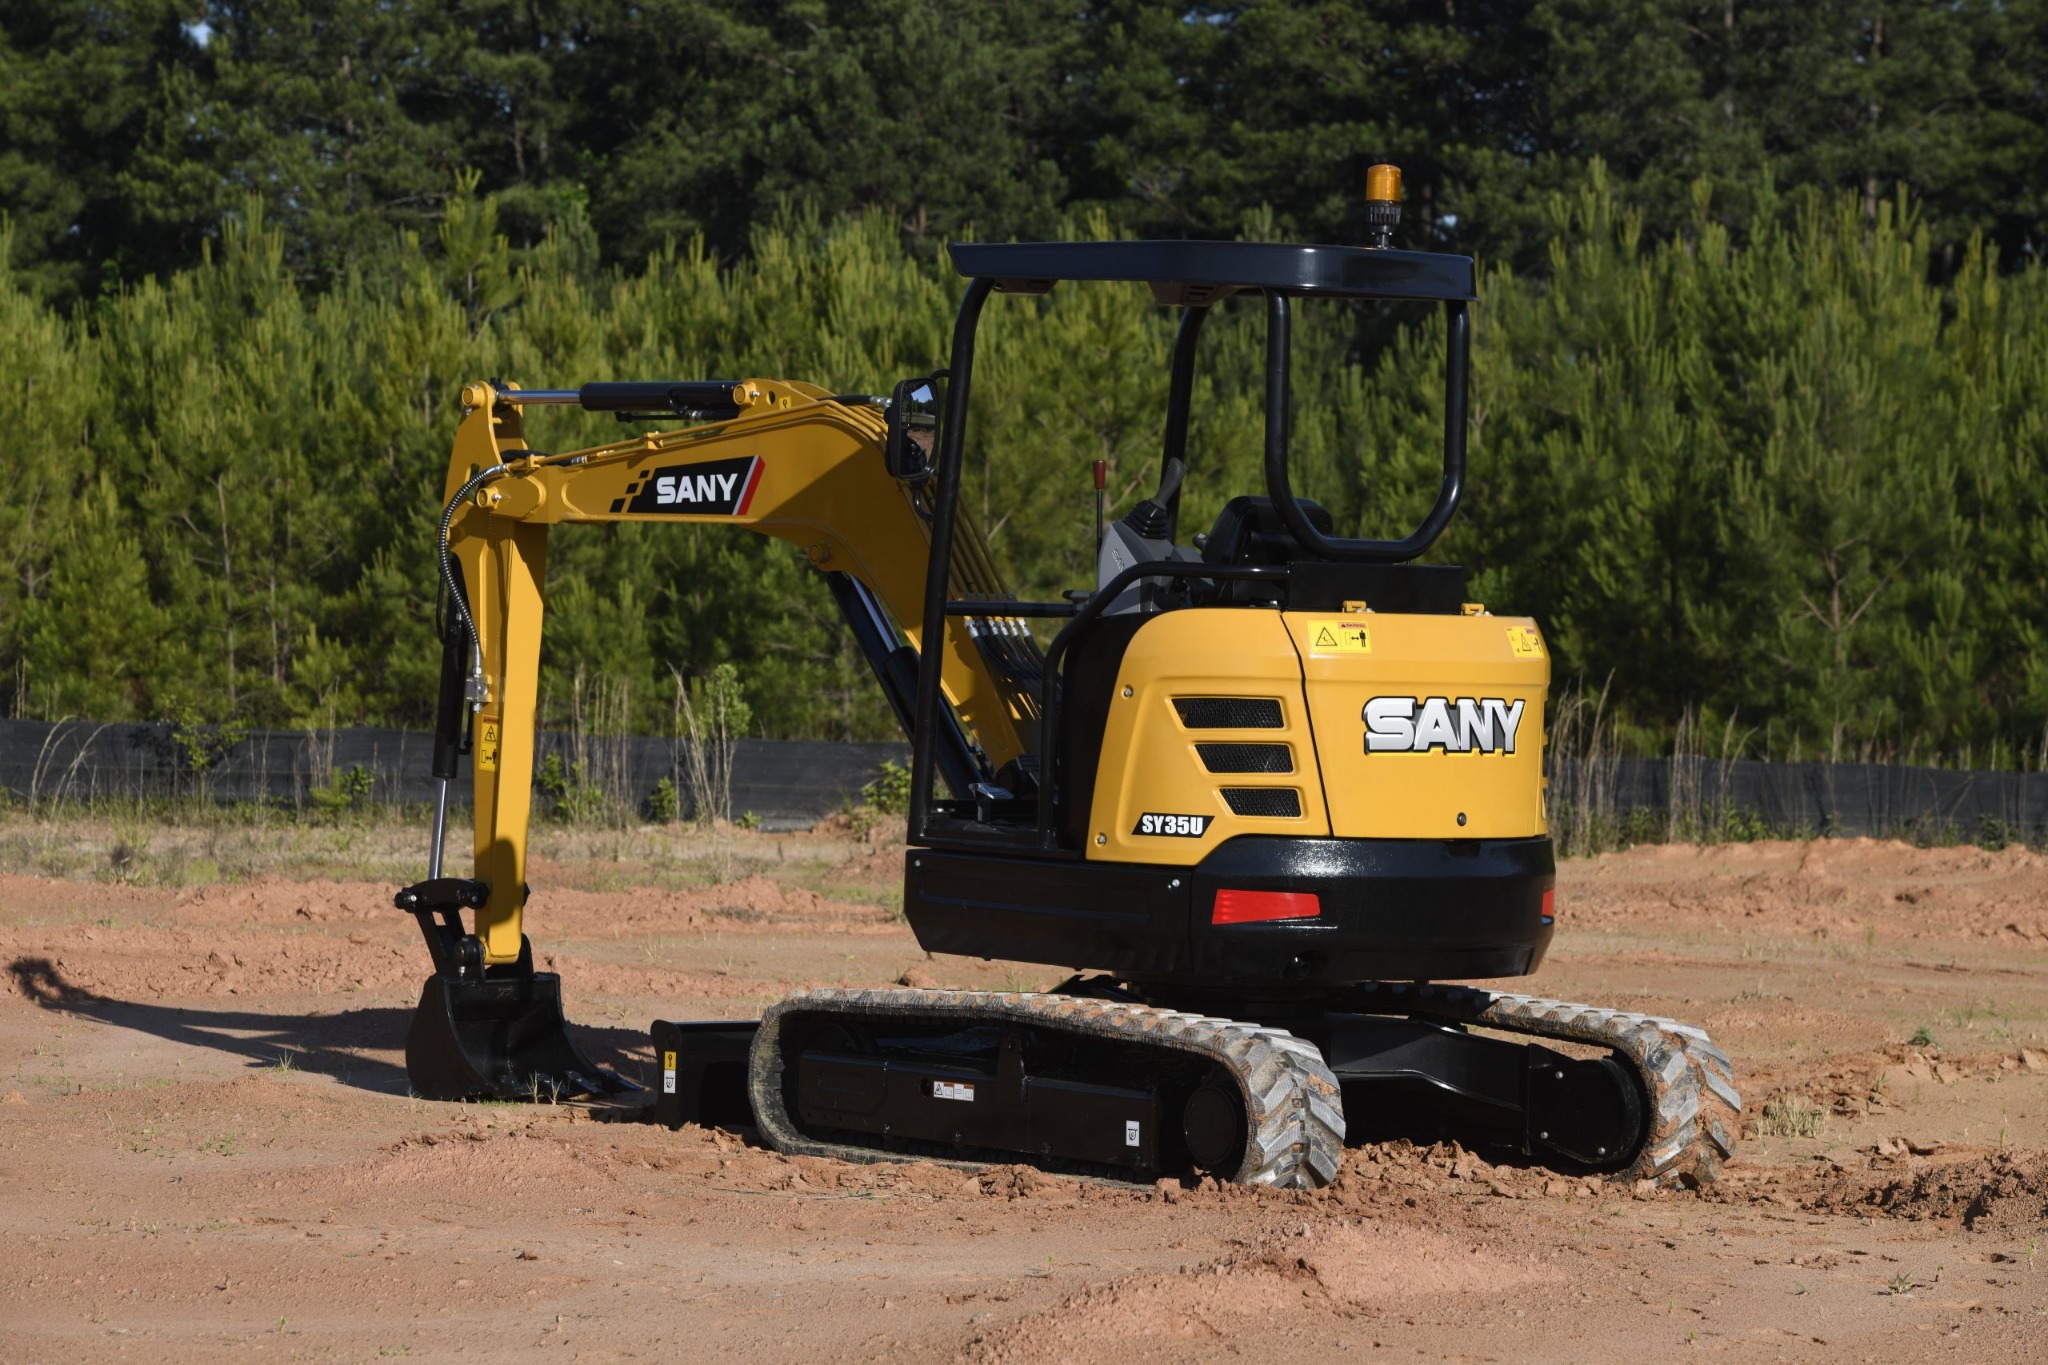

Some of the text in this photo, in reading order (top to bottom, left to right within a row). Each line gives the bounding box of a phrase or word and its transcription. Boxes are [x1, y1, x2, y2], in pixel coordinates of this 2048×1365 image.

[657, 473, 738, 504] SANY
[1111, 549, 1125, 573] SAN
[1362, 696, 1526, 754] SANY
[1142, 815, 1203, 835] SY35U
